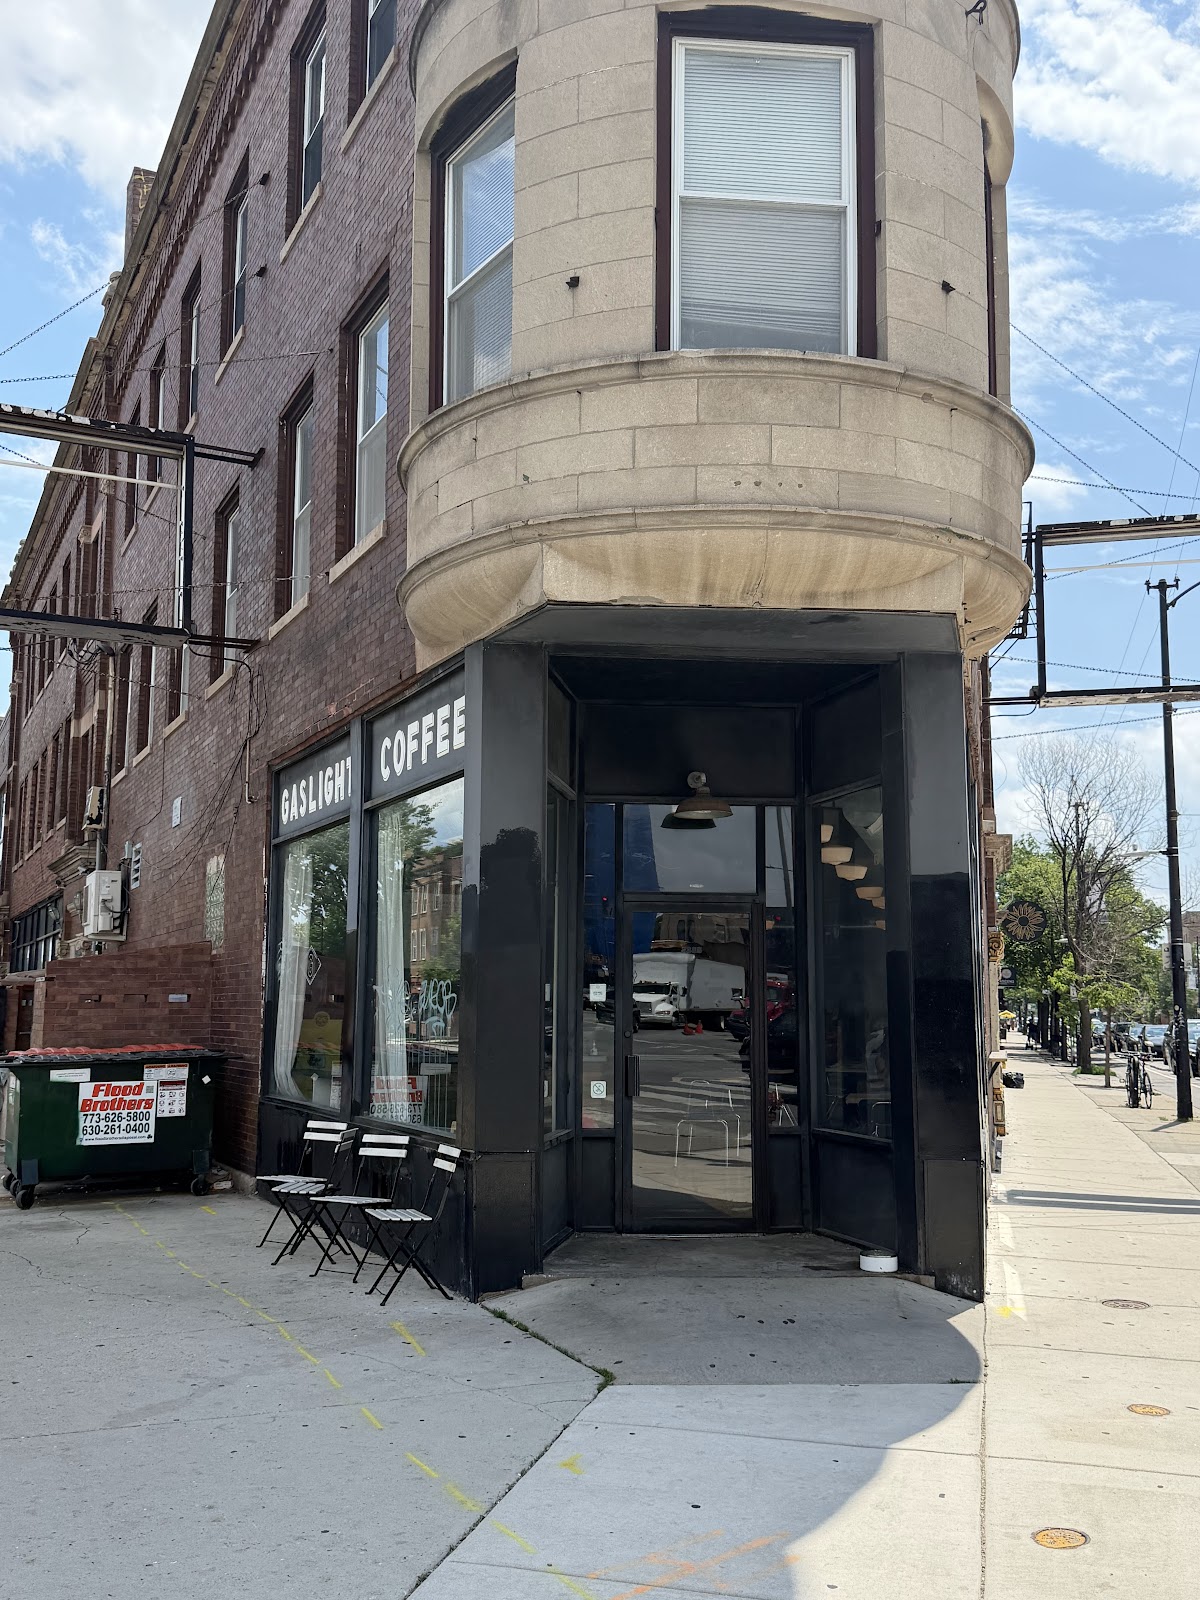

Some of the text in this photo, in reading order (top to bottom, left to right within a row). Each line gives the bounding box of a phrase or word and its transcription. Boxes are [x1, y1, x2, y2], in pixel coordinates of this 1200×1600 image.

[380, 695, 465, 781] COFFEE
[281, 756, 352, 825] GASLIGHT
[92, 1082, 145, 1097] Flood
[80, 1097, 154, 1112] Brothers
[83, 1111, 151, 1124] 773-626-5800
[82, 1123, 150, 1136] 630-261-0400
